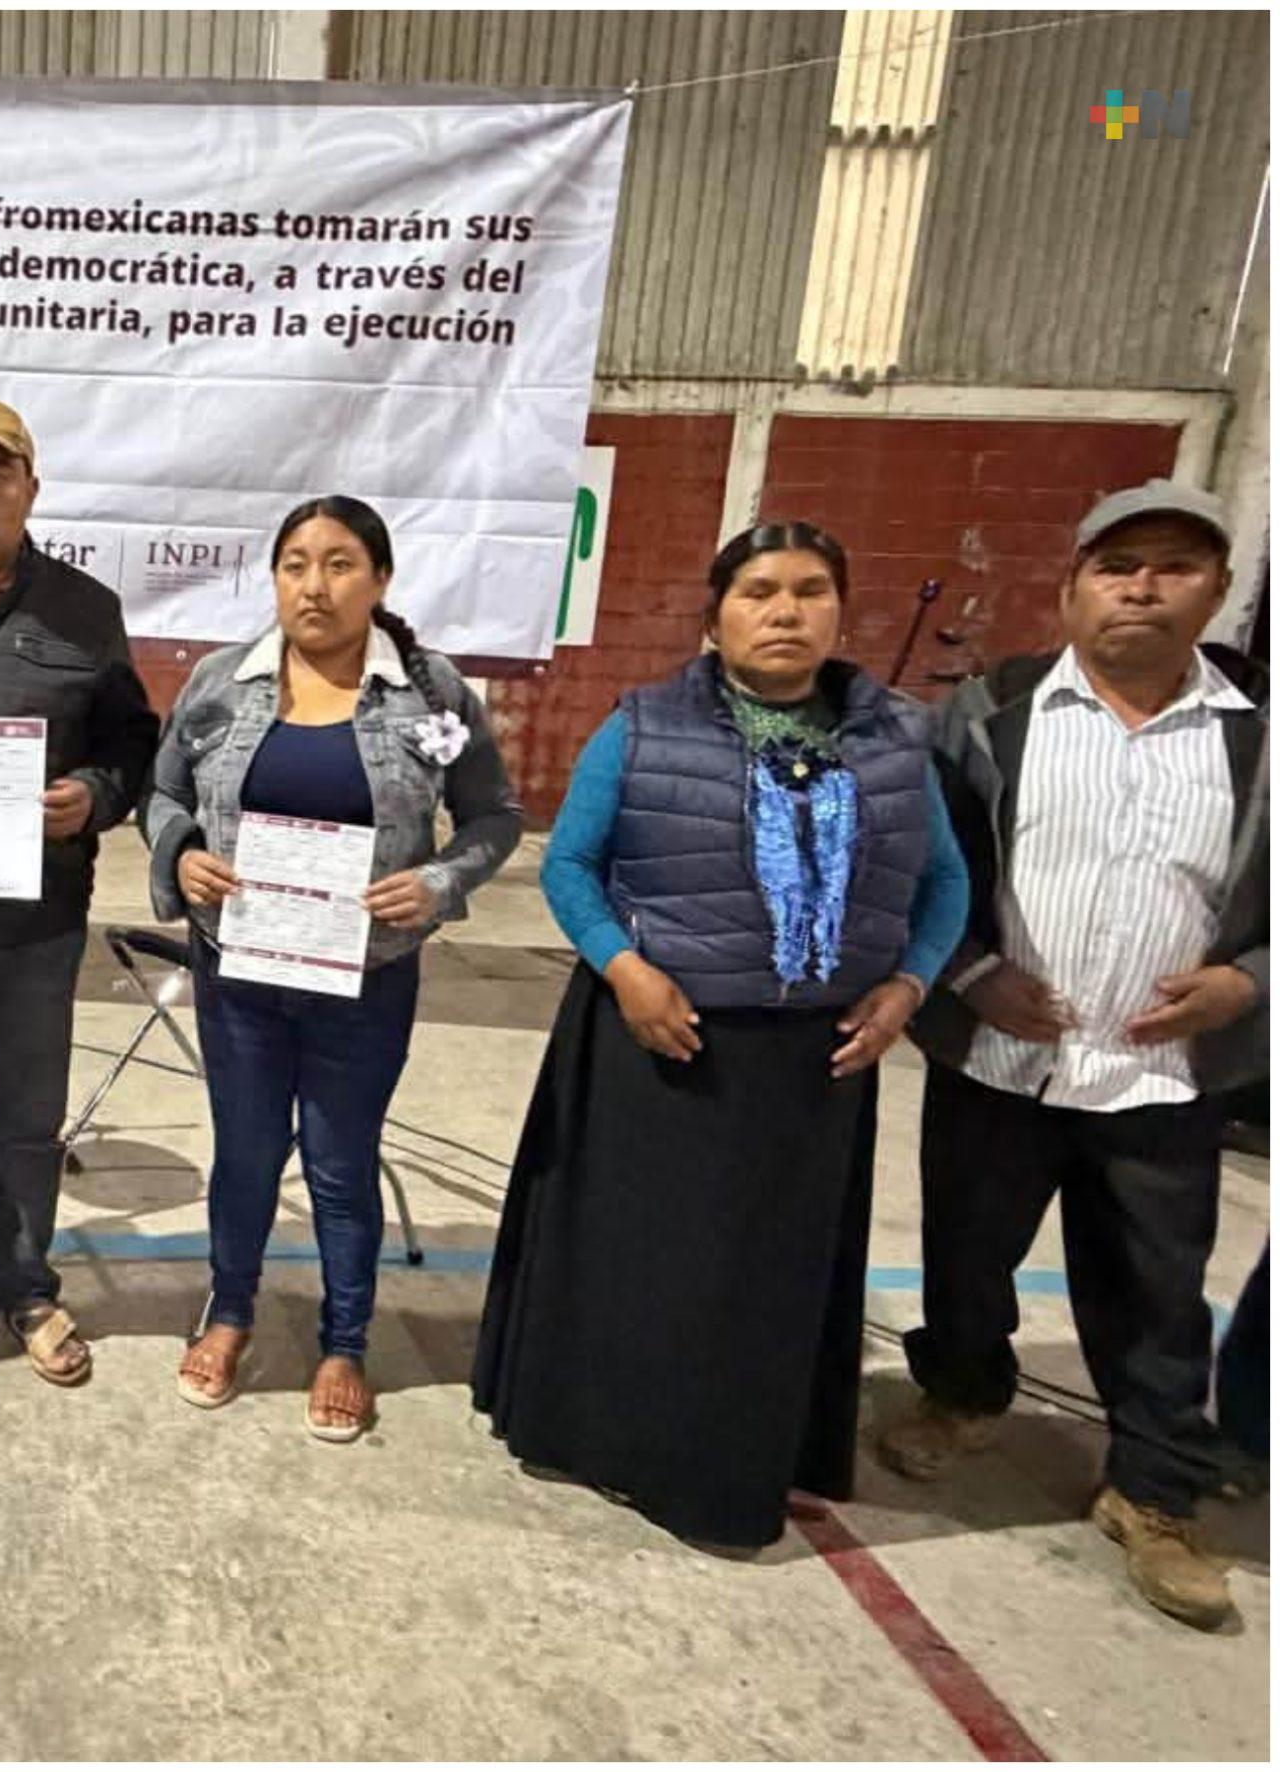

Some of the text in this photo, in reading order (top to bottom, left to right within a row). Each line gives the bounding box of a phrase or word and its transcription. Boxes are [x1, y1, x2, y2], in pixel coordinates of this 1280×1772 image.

[274, 208, 450, 242] tomarán
[465, 213, 535, 242] sus
[274, 263, 297, 291] a
[317, 256, 446, 291] través
[463, 259, 526, 294] del
[169, 308, 257, 343] para
[272, 306, 308, 337] la
[323, 304, 516, 347] ejecución
[42, 536, 97, 567] tar
[145, 541, 223, 568] INPI
